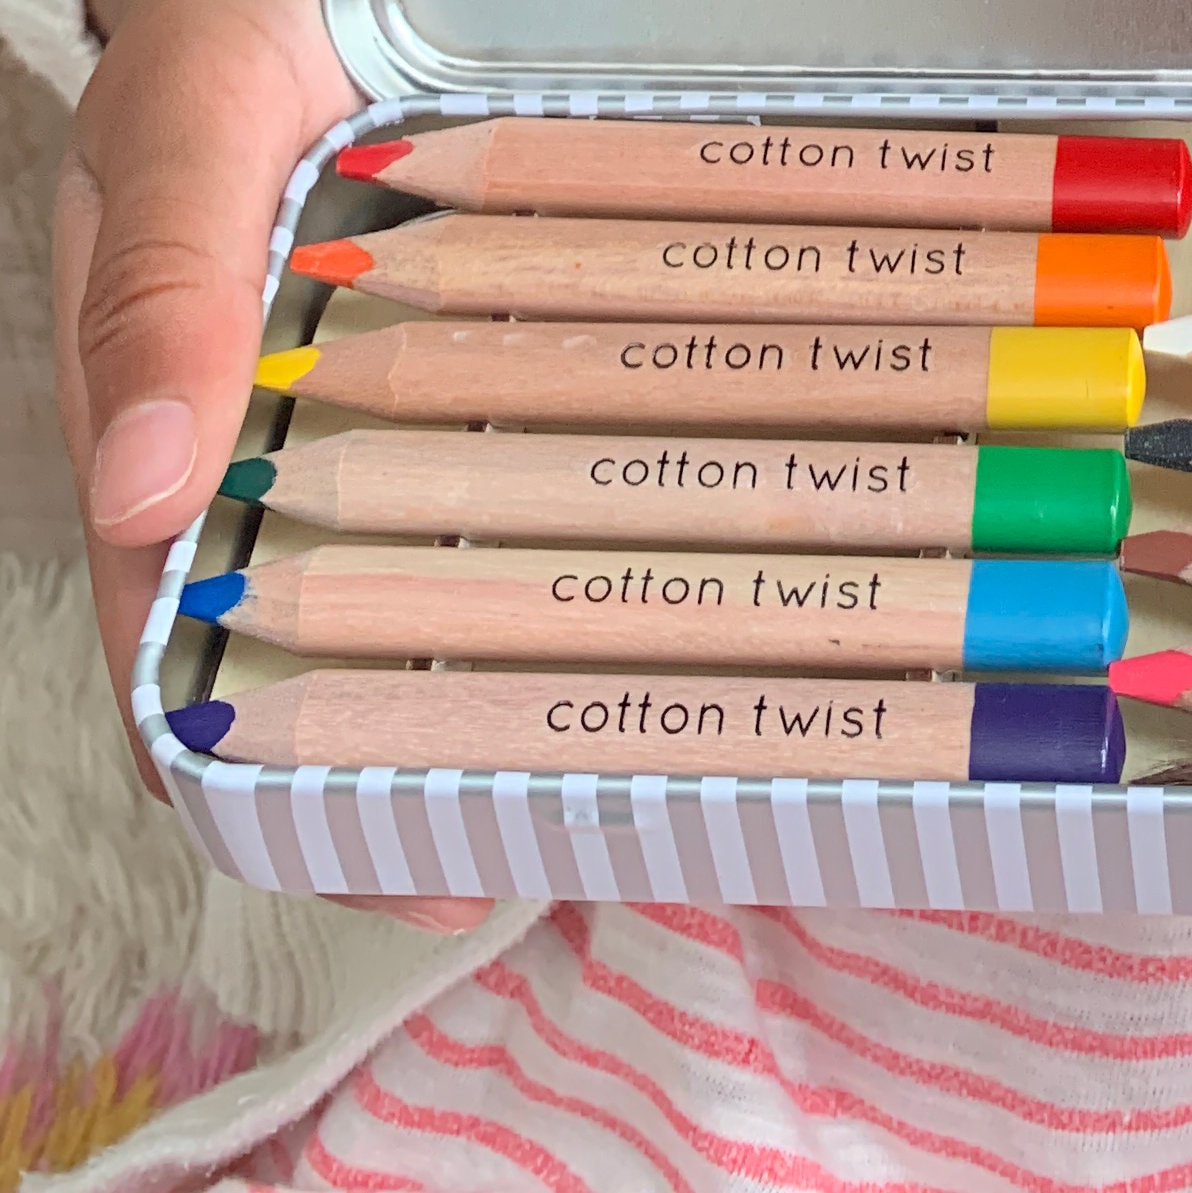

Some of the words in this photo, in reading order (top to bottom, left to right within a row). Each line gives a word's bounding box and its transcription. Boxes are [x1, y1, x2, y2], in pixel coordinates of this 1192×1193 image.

[699, 135, 855, 168] cotton
[878, 139, 997, 173] twist
[662, 236, 821, 273] cotton
[846, 238, 967, 276] twist
[620, 335, 784, 371] cotton
[811, 336, 932, 372] twist
[590, 449, 758, 490] cotton
[784, 453, 910, 493] twist
[551, 567, 724, 606] cotton
[752, 570, 882, 611] twist
[546, 691, 725, 736] cotton
[753, 694, 887, 740] twist
